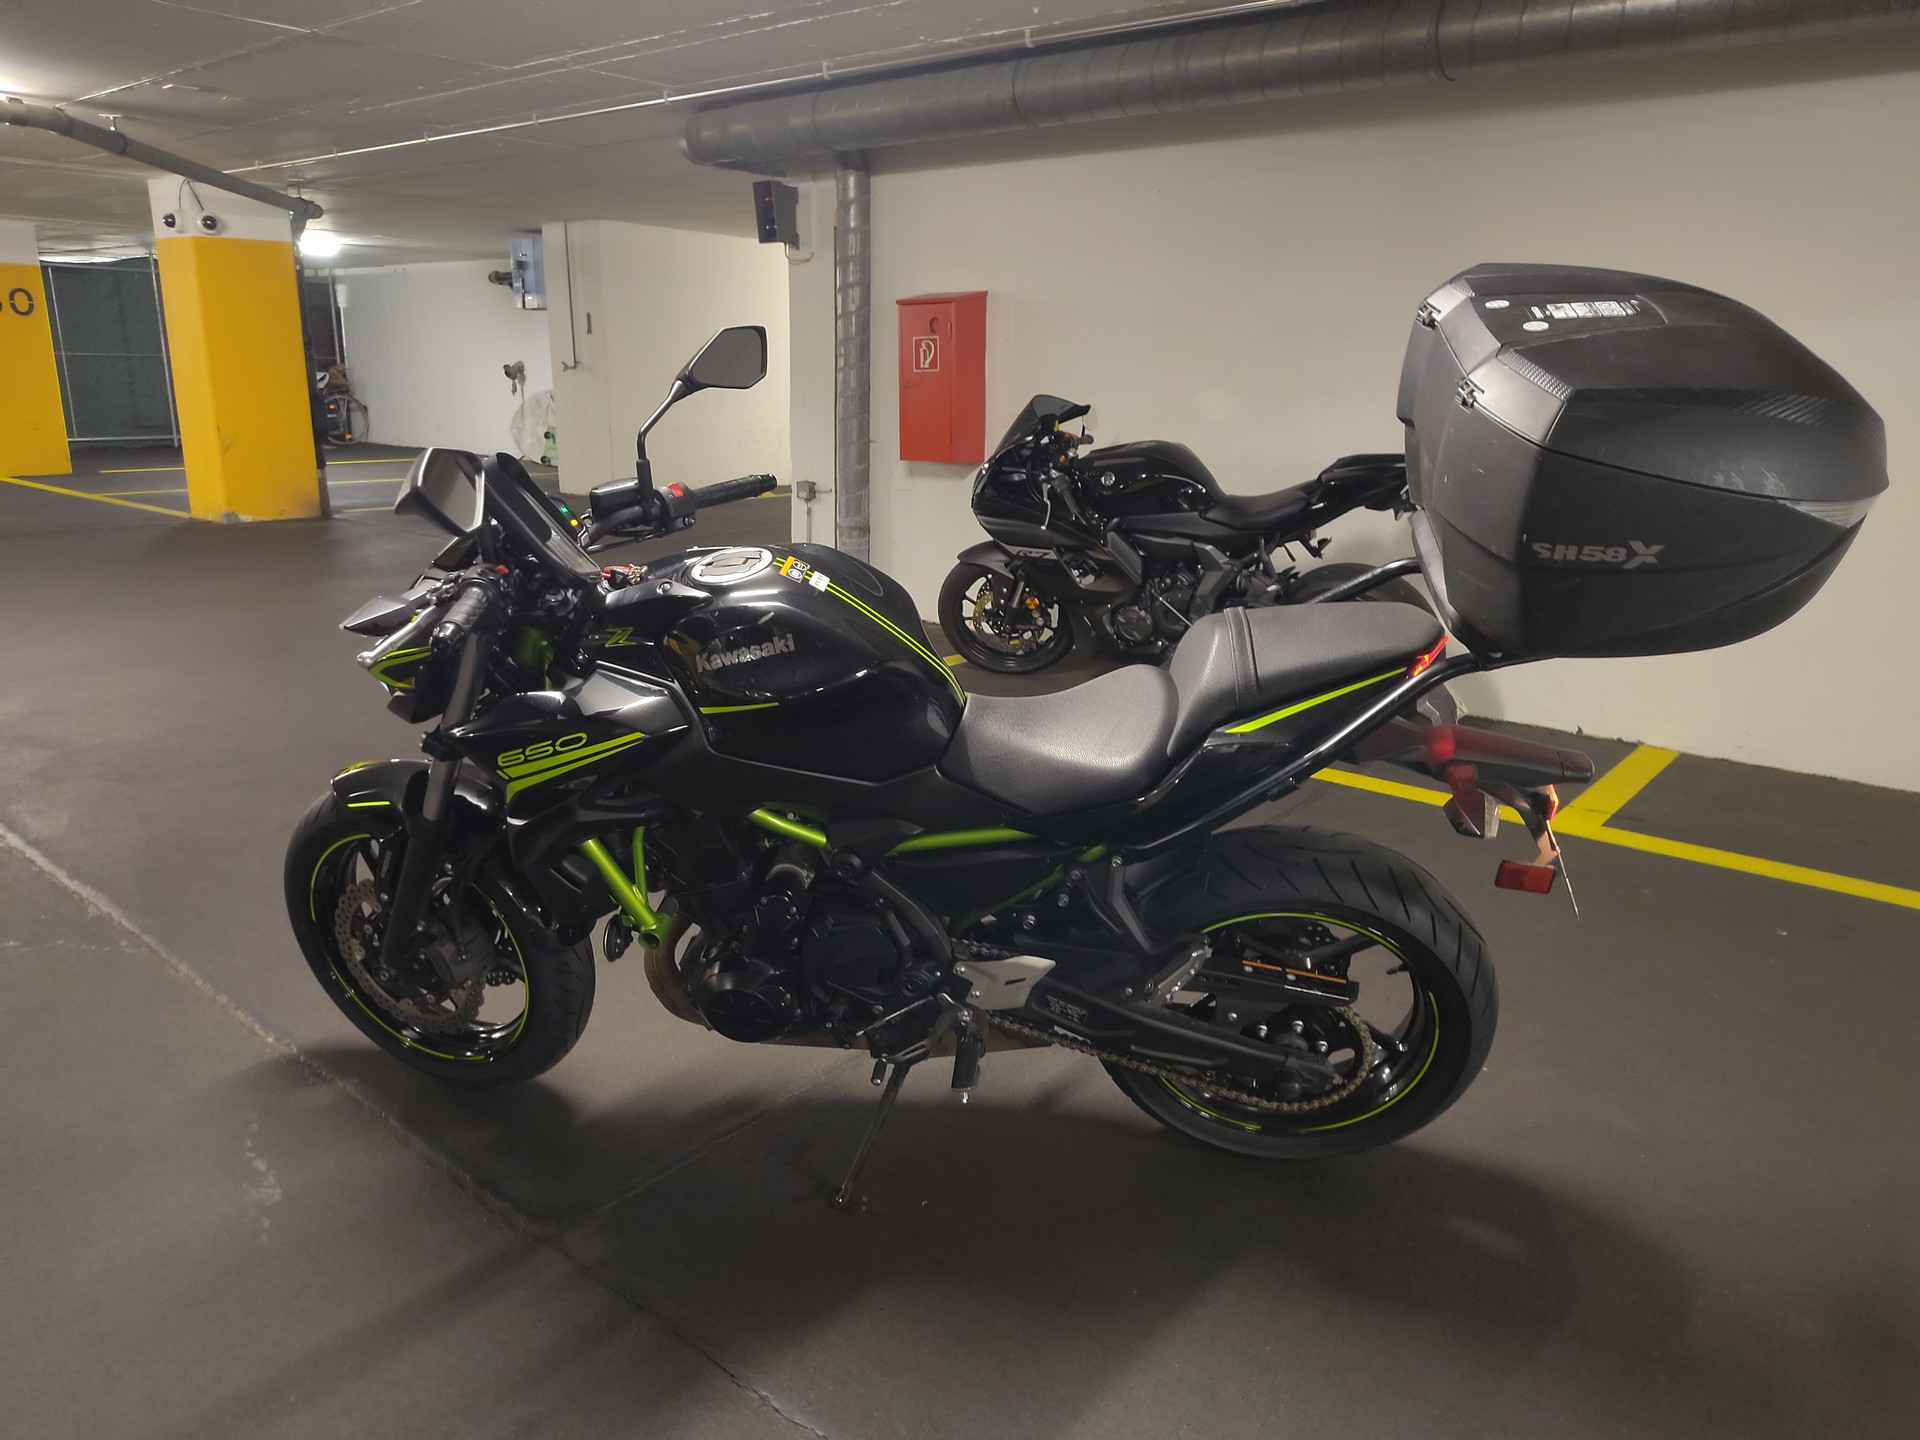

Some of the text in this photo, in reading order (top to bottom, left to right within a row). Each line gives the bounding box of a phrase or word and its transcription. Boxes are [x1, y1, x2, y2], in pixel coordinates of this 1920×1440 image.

[0, 287, 35, 316] 0
[1532, 540, 1665, 569] SH58X
[695, 633, 796, 673] Kawasaki
[497, 732, 588, 767] 650
